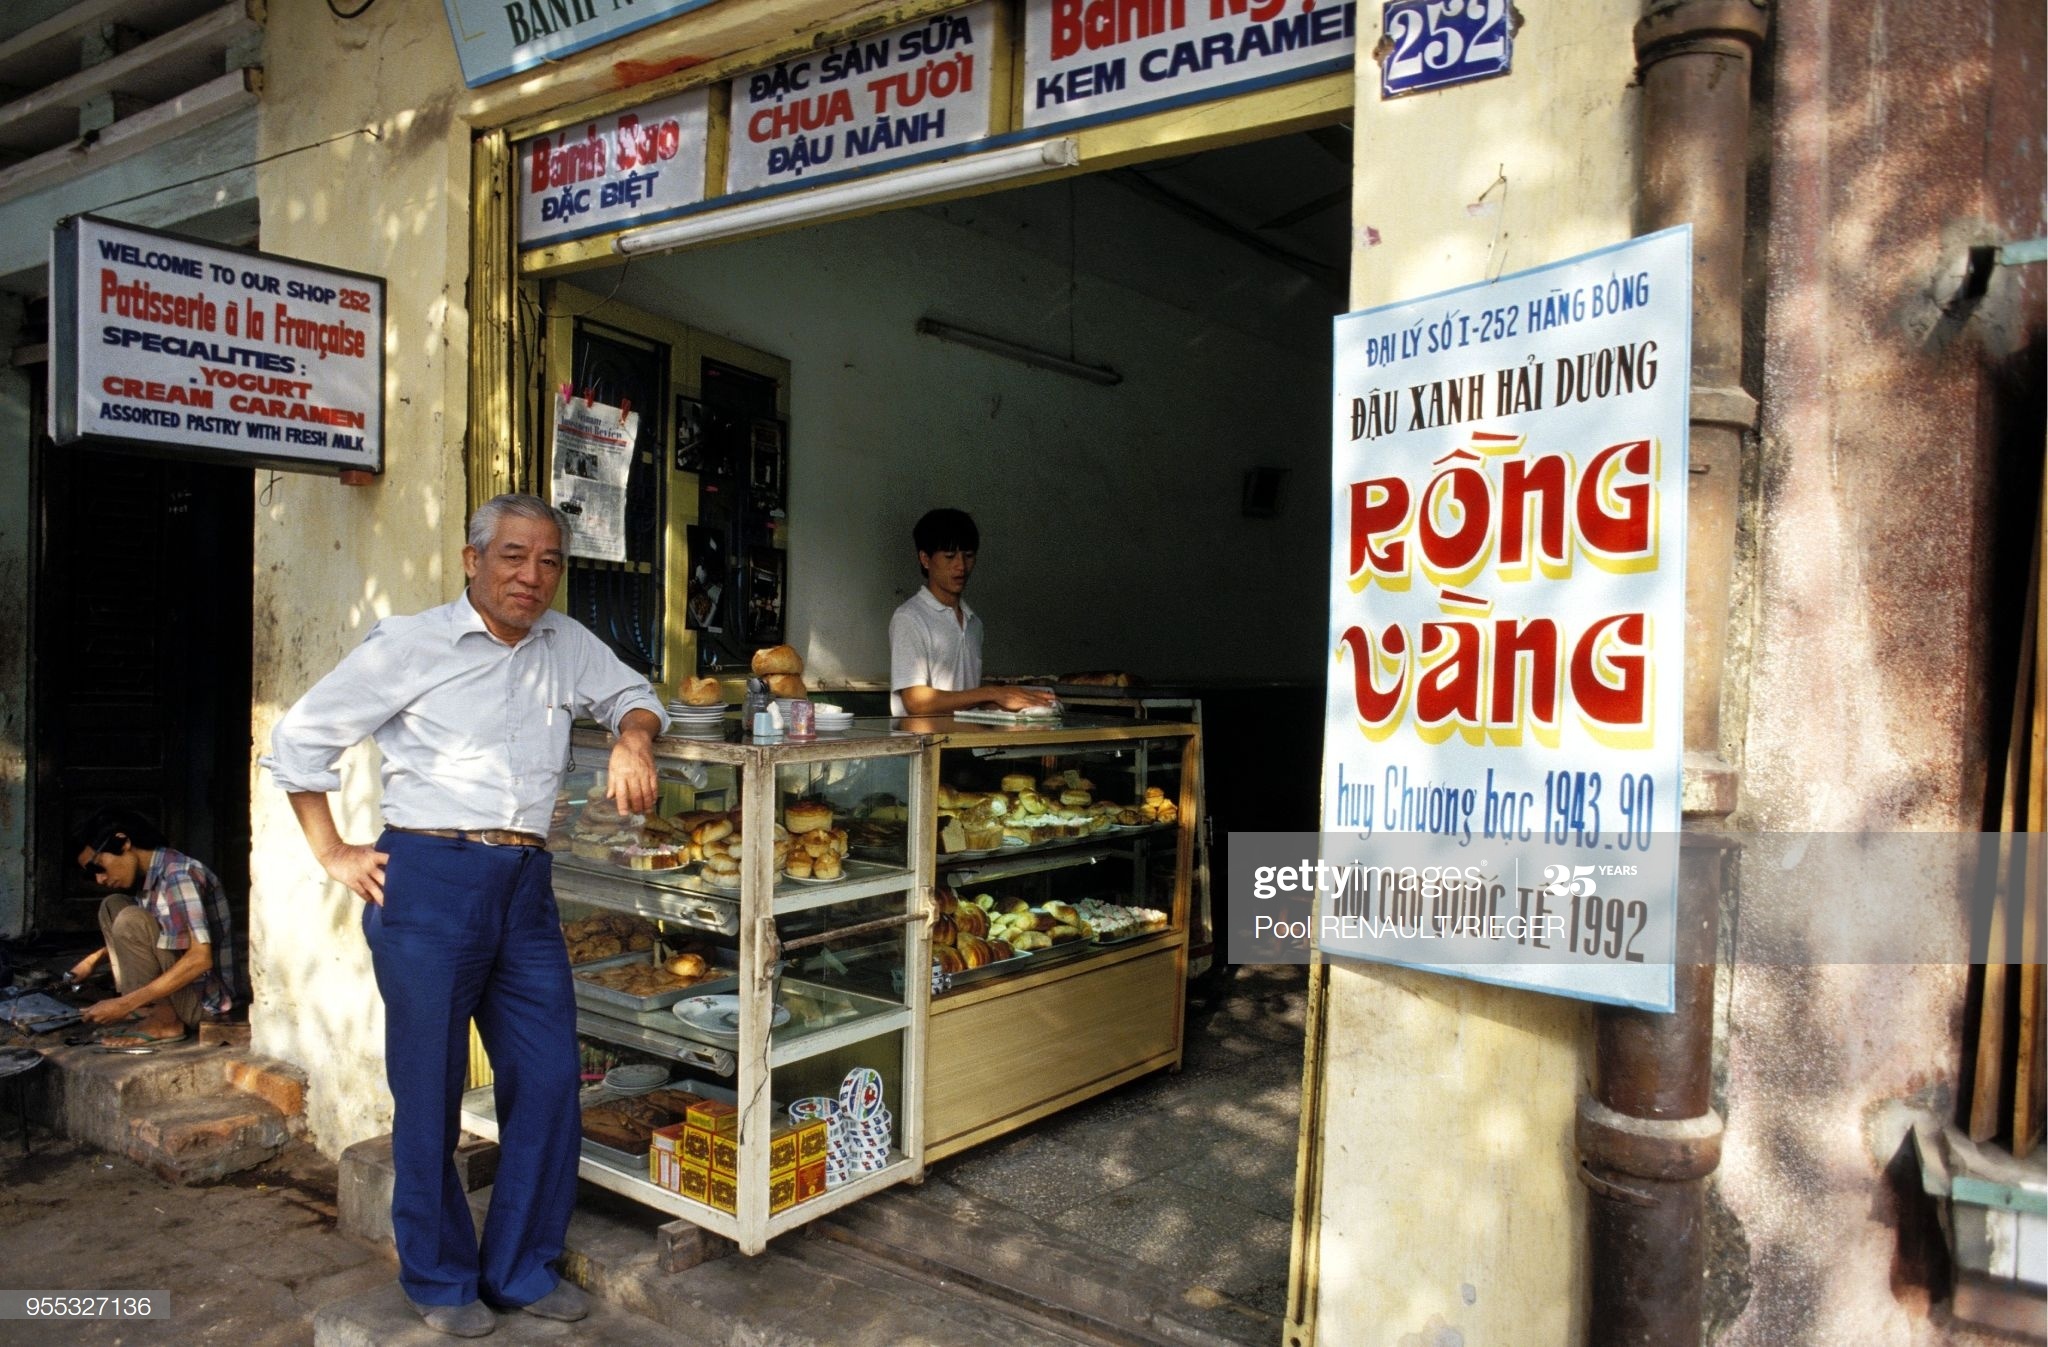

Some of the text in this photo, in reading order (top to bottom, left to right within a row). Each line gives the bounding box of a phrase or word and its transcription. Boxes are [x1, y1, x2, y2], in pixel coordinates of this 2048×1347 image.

[1388, 0, 1504, 80] 252
[748, 51, 974, 143] CHUA TƯƠI
[1036, 57, 1126, 109] KEM
[768, 134, 834, 176] ĐẬU
[542, 170, 659, 223] ĐẶC BIỆT
[98, 239, 370, 313] WELCOME TO OUR SHOP 252
[101, 268, 216, 333] Patisserie
[246, 297, 264, 341] la
[275, 302, 365, 360] Française
[1366, 333, 1396, 369] ĐẠI
[1402, 317, 1424, 360] LÝ
[102, 376, 365, 429] CREAM CARAMEN
[1350, 340, 1658, 441] ĐẬU XANH HẢI DƯƠNG
[100, 402, 364, 452] ASSORTED PASTRY WITH FRESH MILK
[1337, 762, 1375, 840] huy
[1483, 767, 1534, 846] bạc
[1569, 892, 1647, 963] 1992
